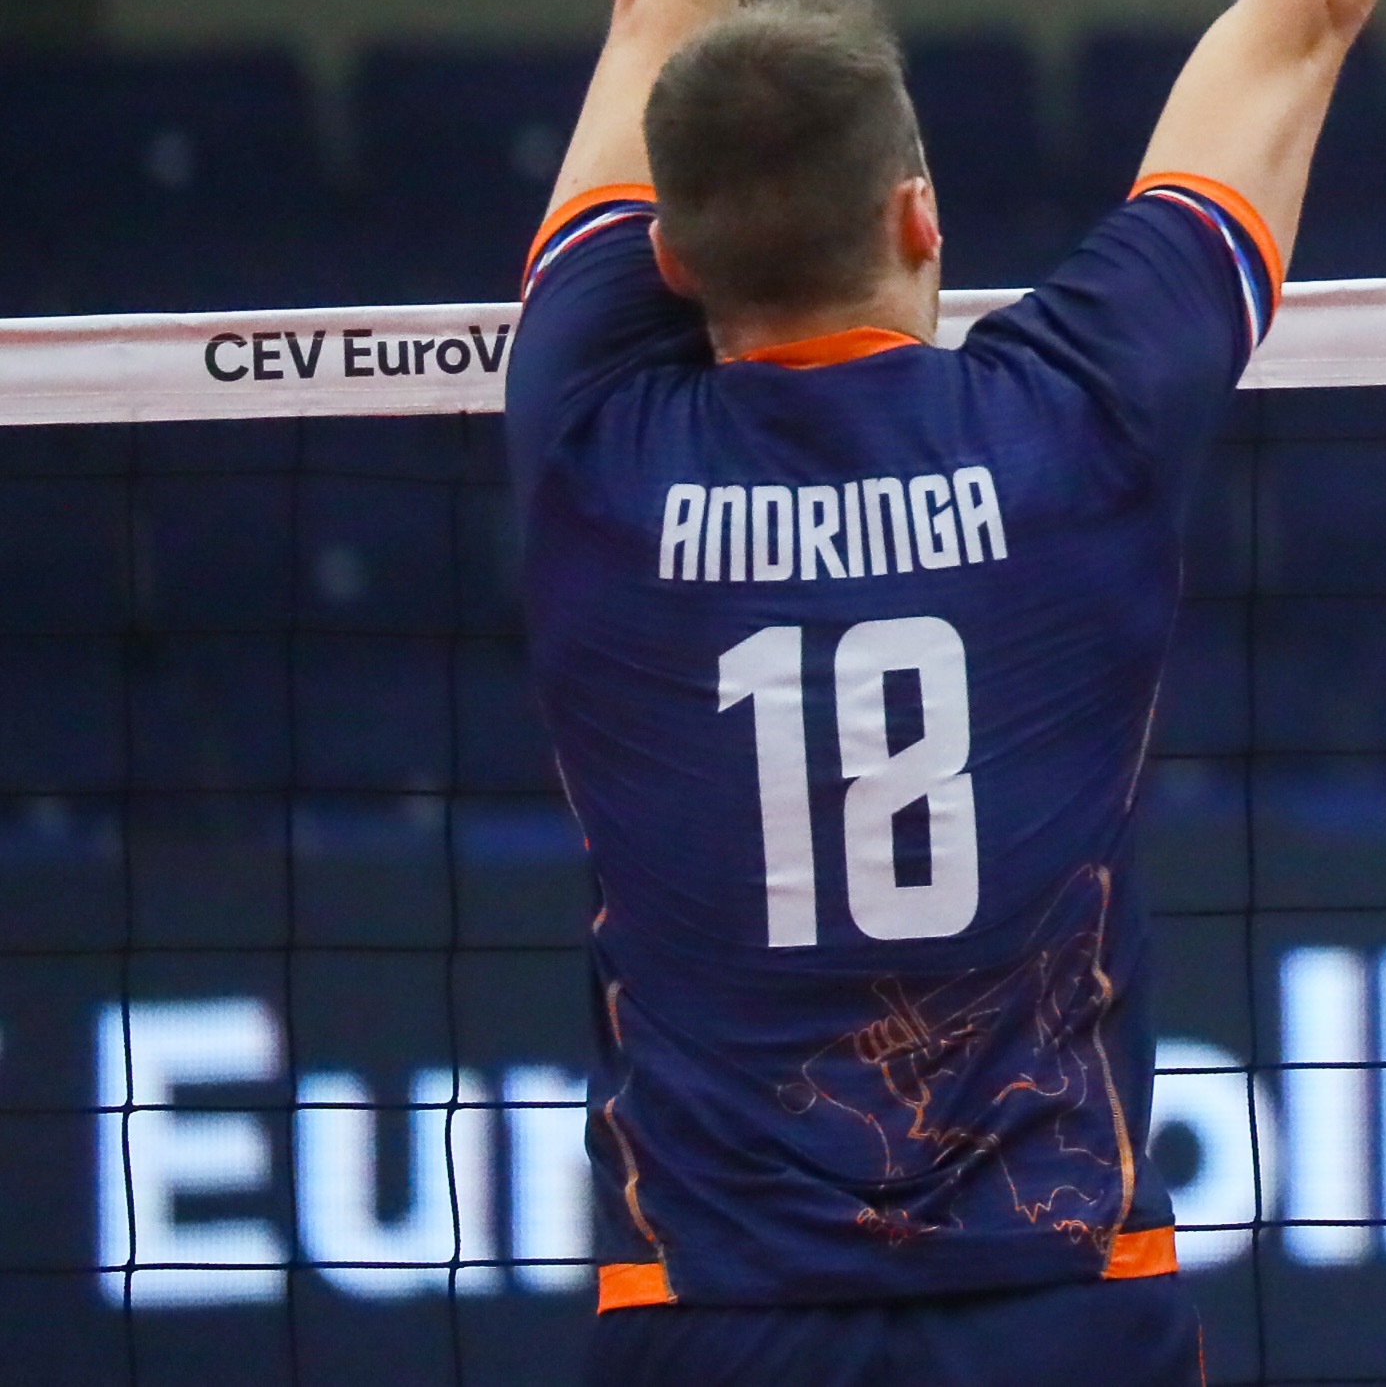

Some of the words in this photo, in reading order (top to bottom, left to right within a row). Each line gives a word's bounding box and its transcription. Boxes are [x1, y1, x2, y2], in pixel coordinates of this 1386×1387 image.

[204, 330, 326, 382] CEV
[343, 323, 511, 377] EuroV
[659, 466, 1008, 582] ANDRINGA
[718, 616, 979, 947] 18
